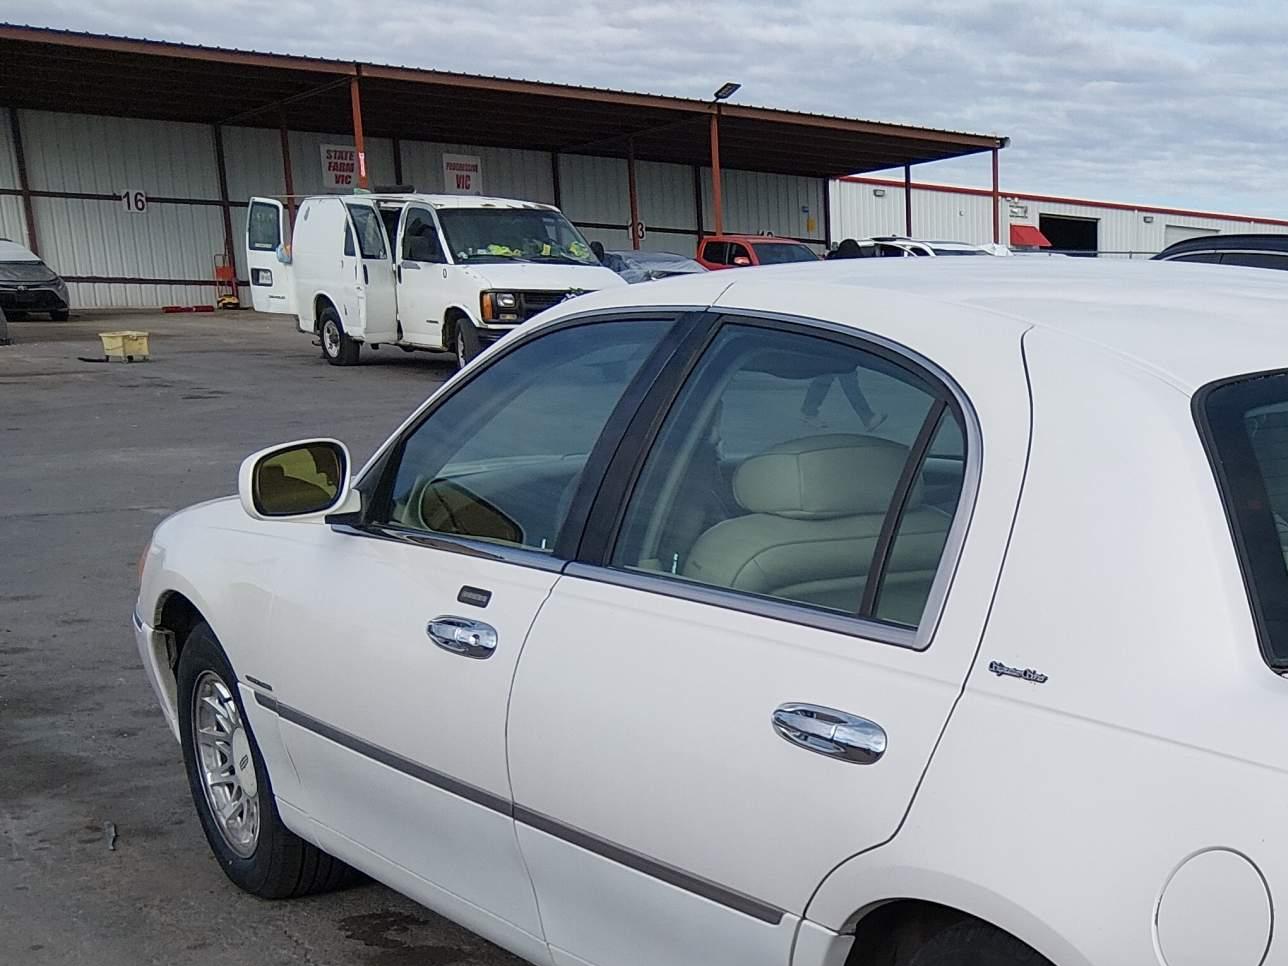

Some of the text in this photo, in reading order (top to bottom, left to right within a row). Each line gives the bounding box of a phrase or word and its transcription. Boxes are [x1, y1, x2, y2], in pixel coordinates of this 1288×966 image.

[326, 149, 354, 160] STATE
[327, 162, 355, 173] FARM
[334, 174, 352, 185] VIC
[455, 174, 471, 190] VIC
[122, 191, 146, 212] 16
